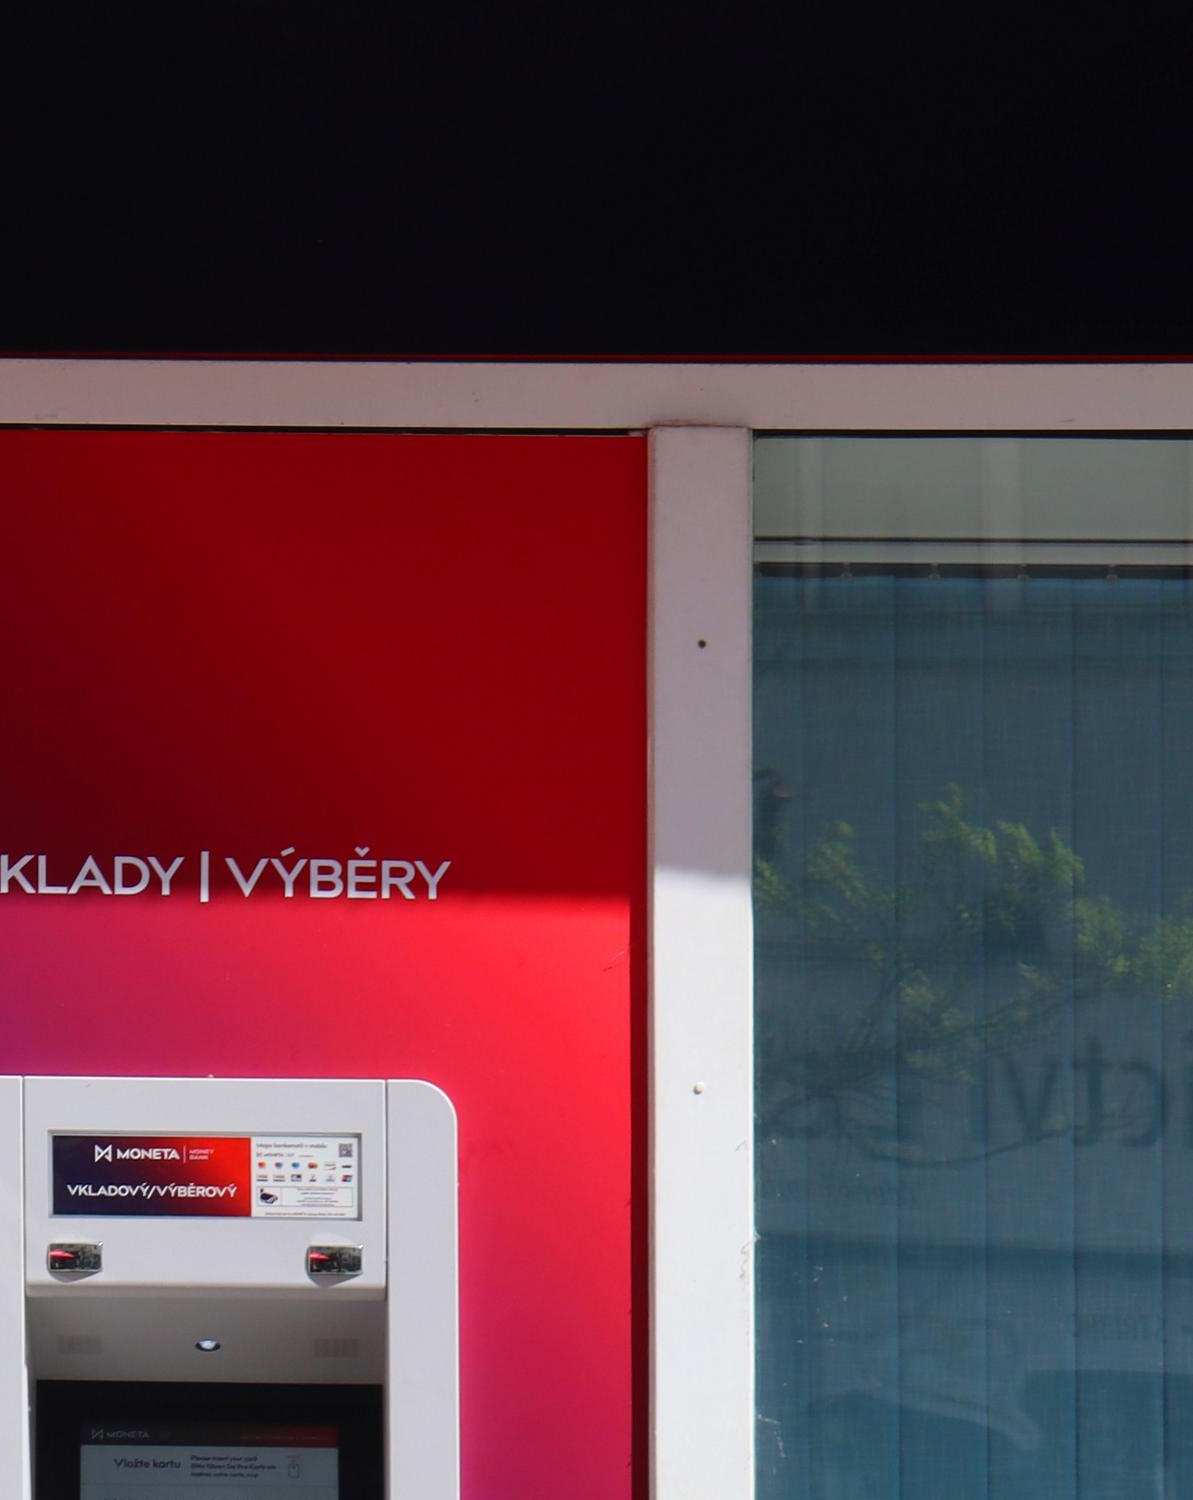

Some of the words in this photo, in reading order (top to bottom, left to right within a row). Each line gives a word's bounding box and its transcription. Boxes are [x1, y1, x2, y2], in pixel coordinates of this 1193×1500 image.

[224, 846, 452, 900] VÝBĚRY
[116, 1147, 180, 1161] MONETA
[66, 1181, 238, 1200] VKLADOVÝ/VÝBĚROVÝ
[106, 1430, 150, 1439] MONETA
[113, 1457, 150, 1469] Vložte
[153, 1458, 182, 1469] kartu
